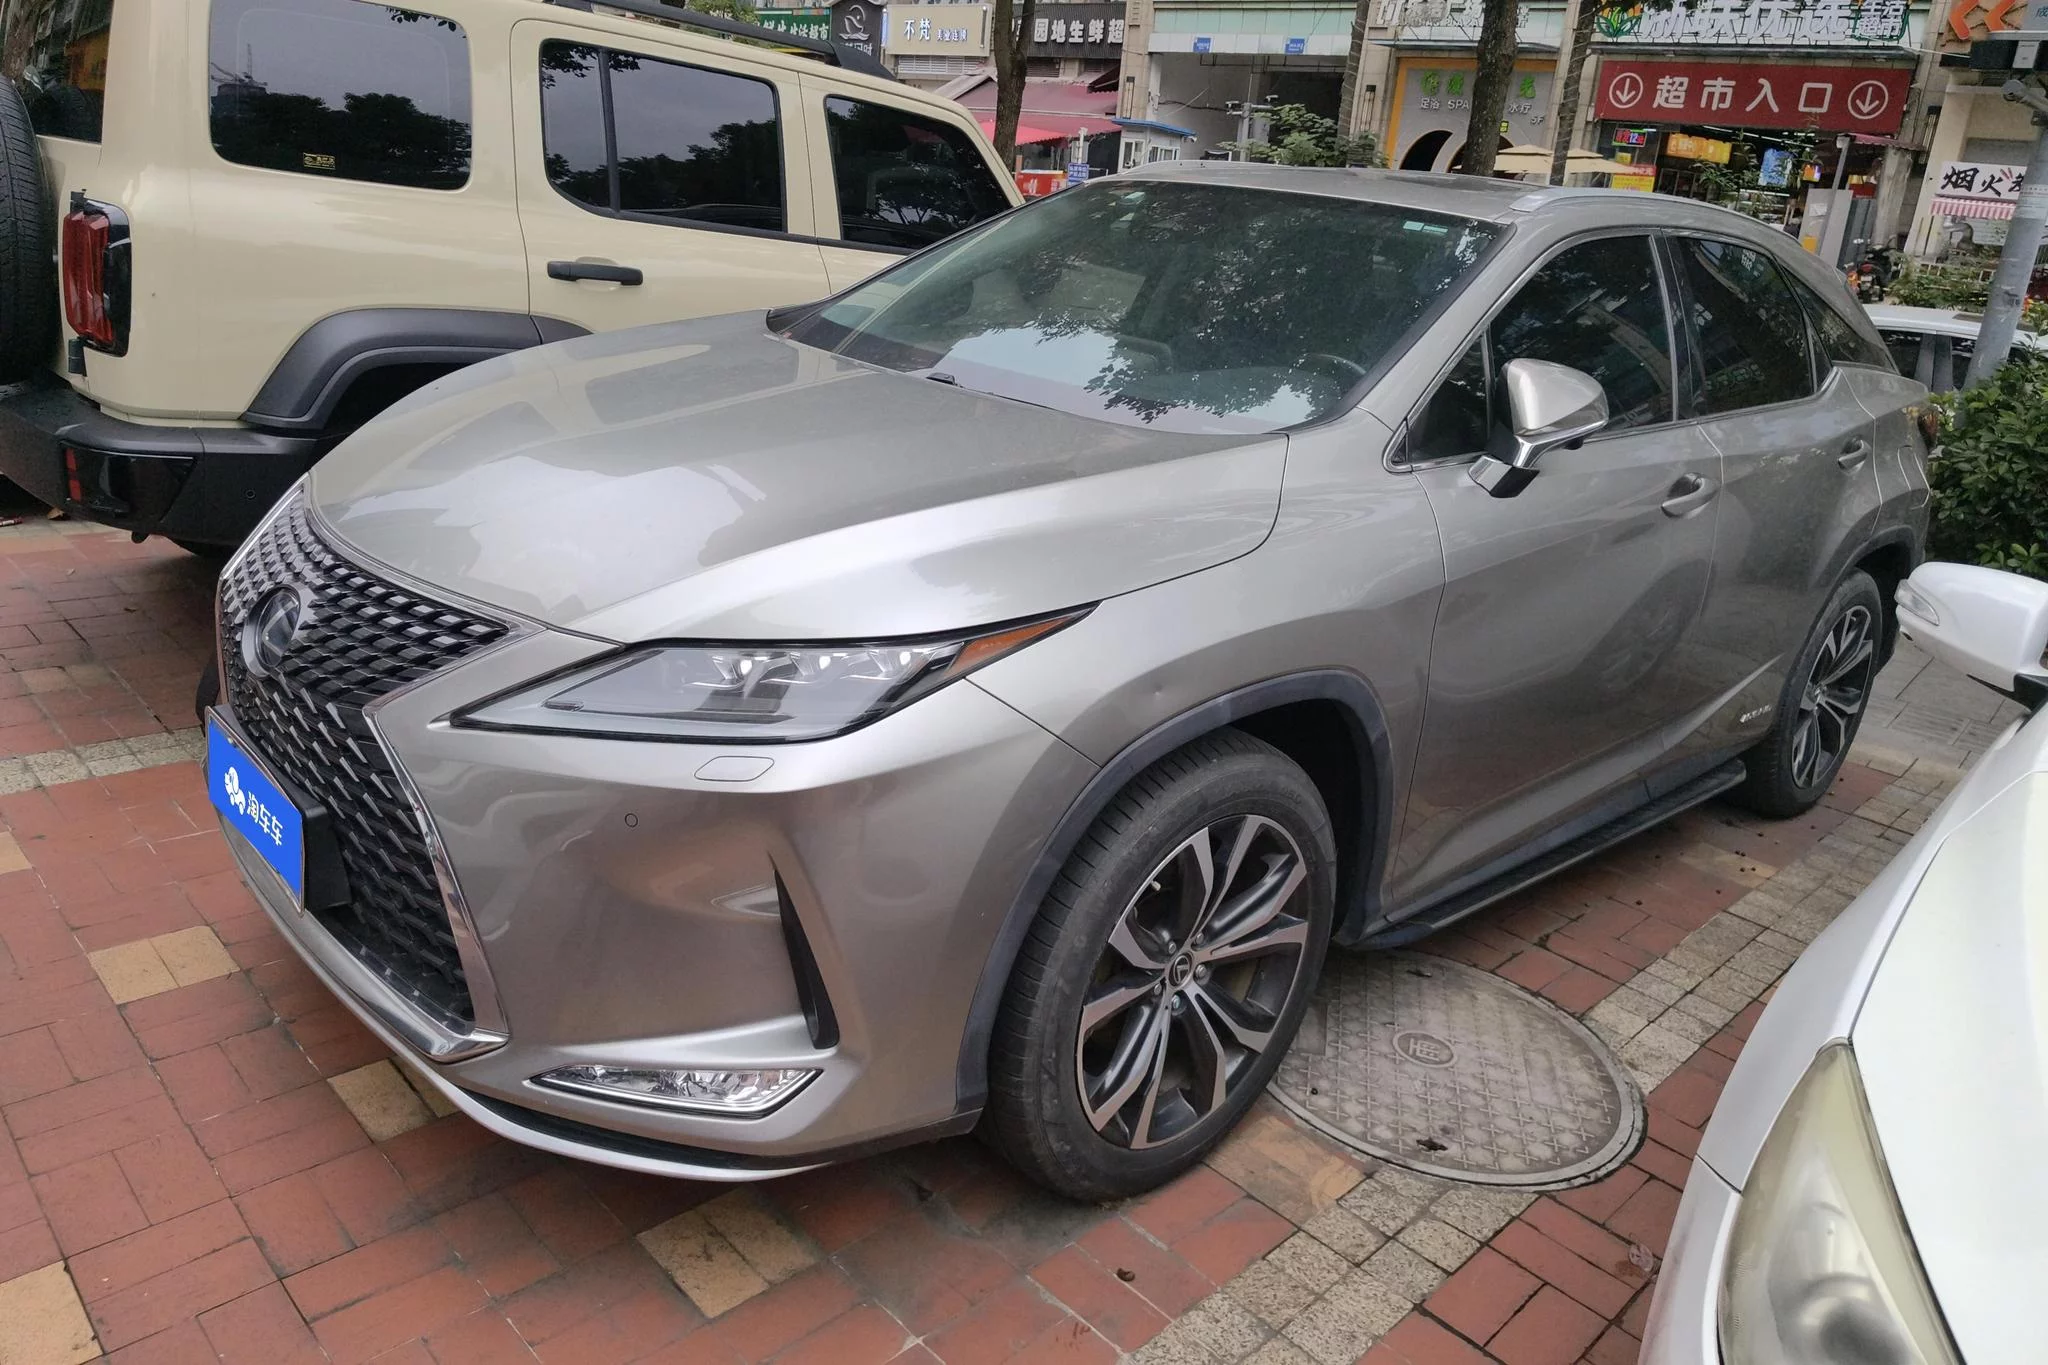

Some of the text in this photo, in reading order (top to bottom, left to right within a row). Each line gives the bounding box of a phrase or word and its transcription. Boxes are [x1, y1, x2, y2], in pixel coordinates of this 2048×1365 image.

[1858, 15, 1902, 37] 超市
[1653, 75, 1833, 113] 超市入口
[1420, 96, 1532, 115] 足浴 SPA 水疗
